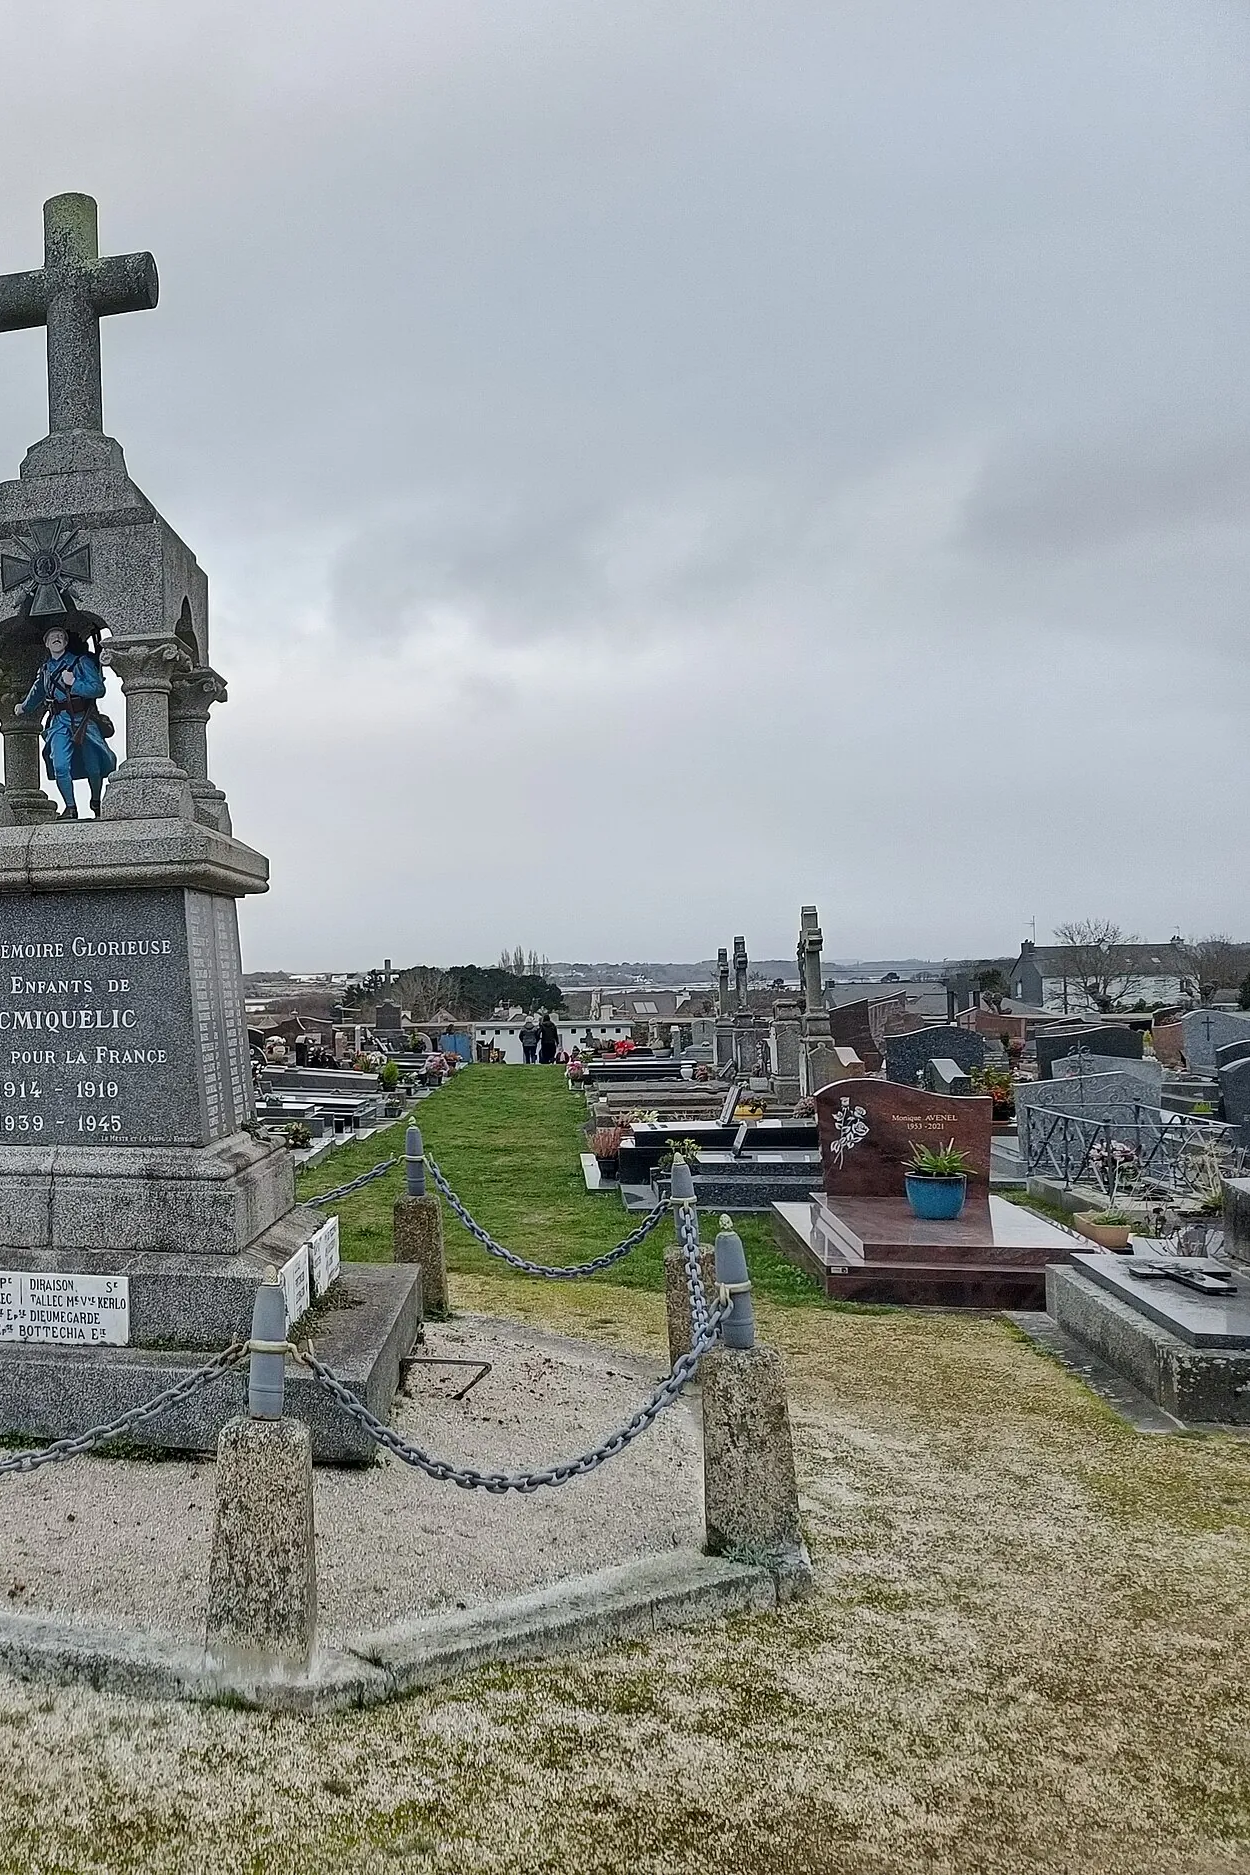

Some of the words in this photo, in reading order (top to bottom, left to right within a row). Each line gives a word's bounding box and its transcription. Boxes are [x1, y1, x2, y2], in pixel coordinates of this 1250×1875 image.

[72, 937, 172, 957] GLORIEUSE
[10, 977, 92, 995] ENFANTS
[108, 979, 130, 993] DE
[10, 1050, 55, 1064] POUR
[65, 1050, 87, 1064] LA
[95, 1046, 167, 1064] FRANCE
[77, 1114, 122, 1132] 1945
[892, 1114, 921, 1122] Monique
[30, 1294, 63, 1307] TALLEC
[97, 1297, 126, 1310] KERLO
[30, 1309, 100, 1324] DIEUMEGARDE
[19, 1325, 85, 1339] BOTTECHIA
